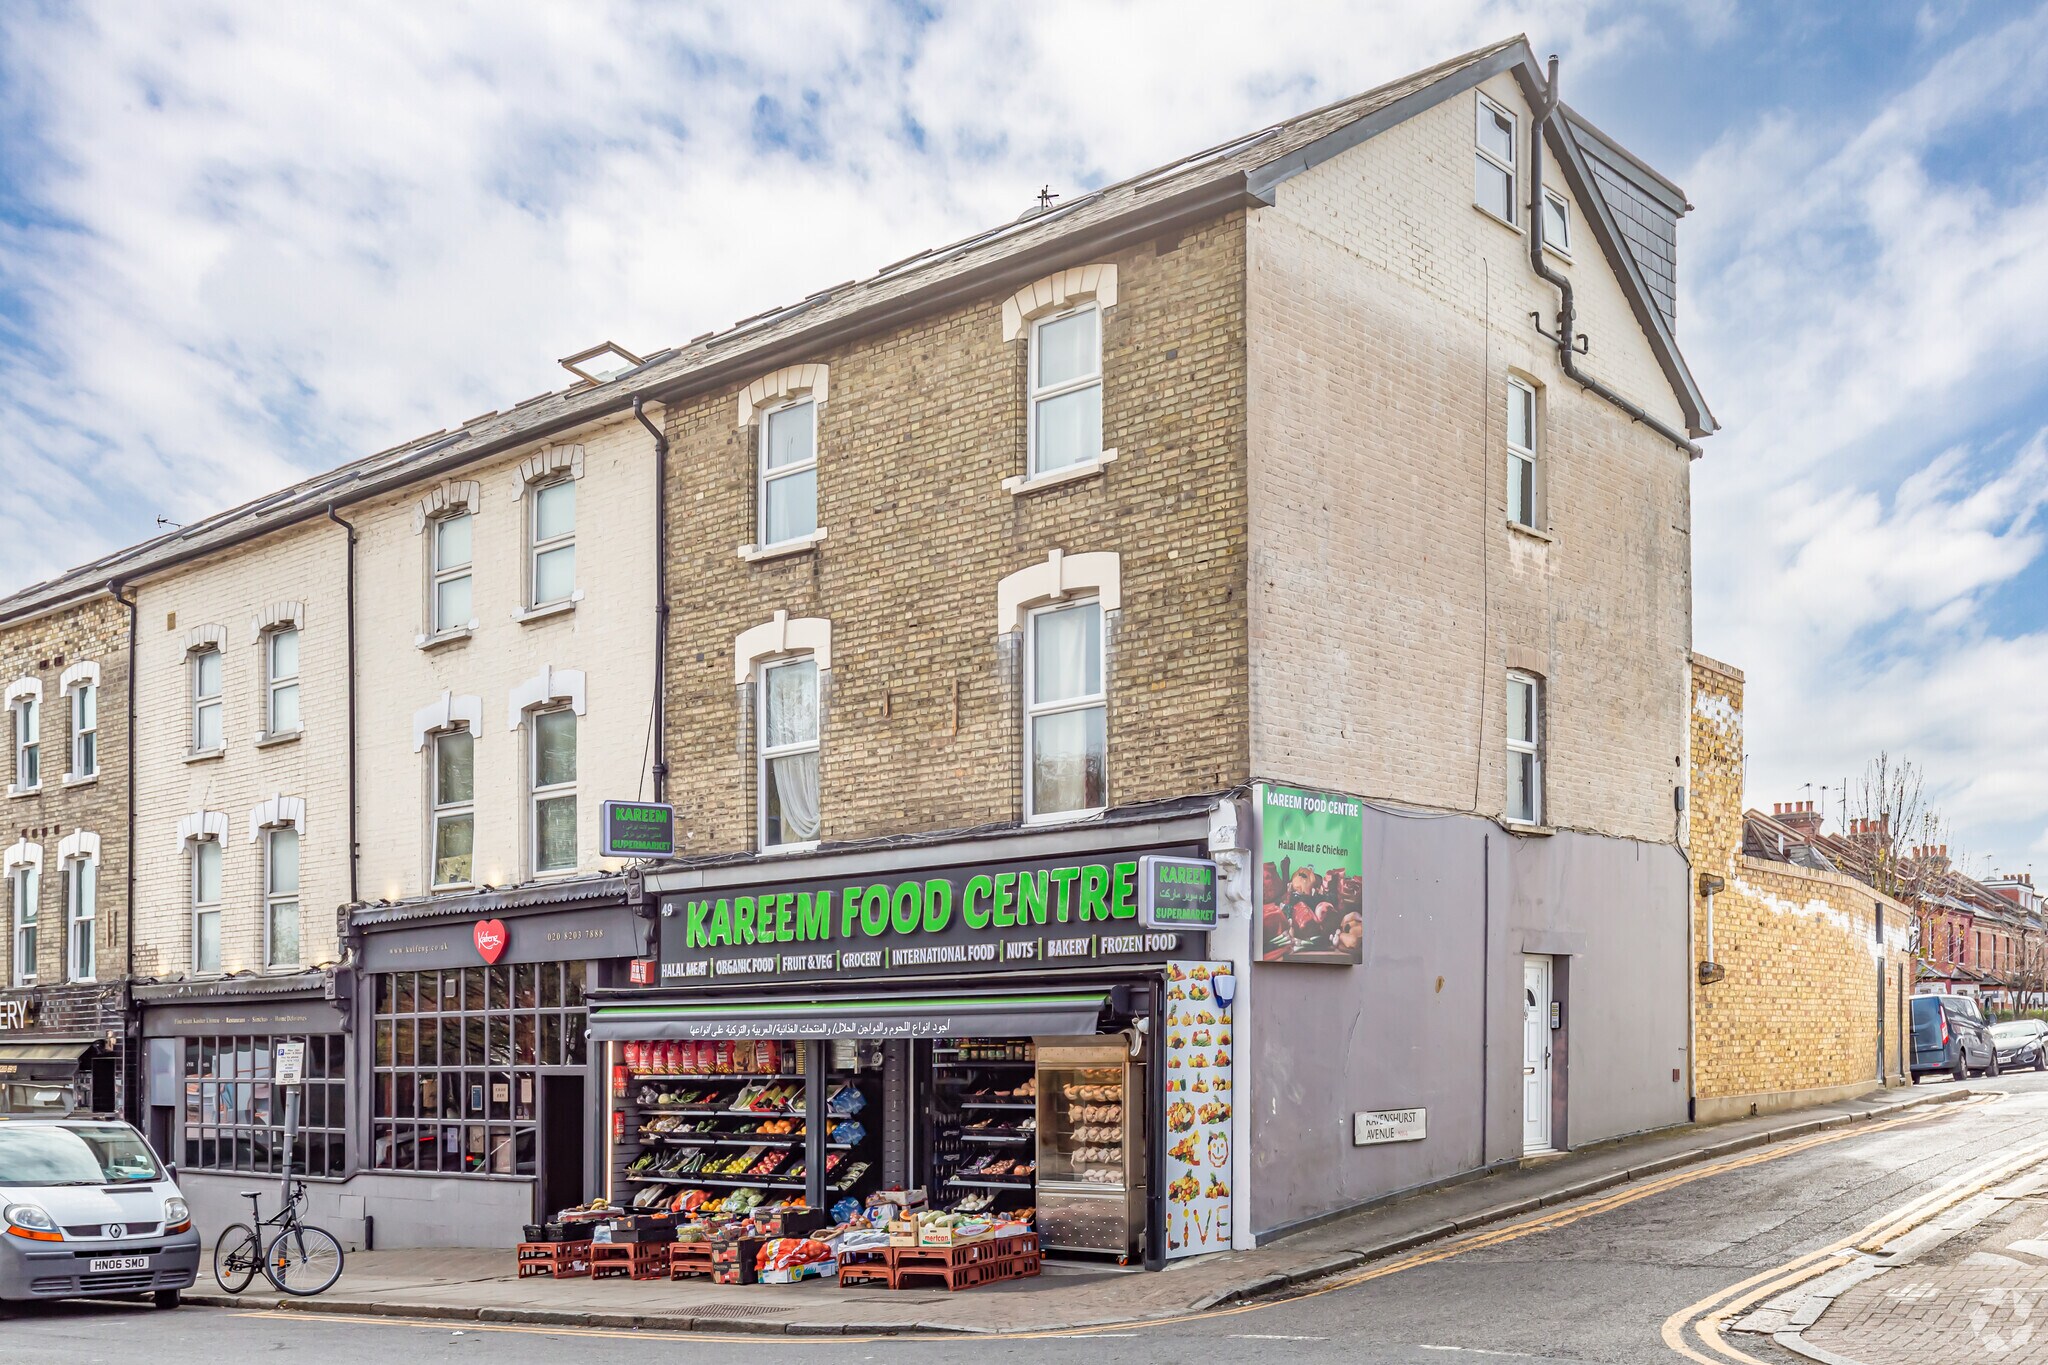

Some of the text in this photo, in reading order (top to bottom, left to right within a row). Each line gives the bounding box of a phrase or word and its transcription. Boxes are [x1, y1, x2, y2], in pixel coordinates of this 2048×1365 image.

[1267, 792, 1358, 817] KAREEM FOOD CENTRE
[616, 808, 668, 823] KAREEM
[612, 839, 671, 850] SUPERMARKET
[1278, 840, 1348, 856] Halal Meat & Chicken
[1160, 865, 1212, 886] KAREEM
[661, 903, 673, 918] 49
[686, 861, 1138, 949] KAREEM FOOD CENTRE
[1156, 907, 1215, 921] SUPERMARKET
[547, 932, 561, 941] 020
[1100, 933, 1177, 954] FROZEN FOOD
[892, 943, 995, 966] INTERNATIONAL FOOD
[1006, 940, 1034, 959] NUTS
[1047, 938, 1089, 958] BAKERY
[716, 956, 774, 976] ORGANIC FOOD
[782, 956, 807, 972] FRUIT
[842, 950, 882, 968] GROCERY
[661, 962, 686, 978] HALAL
[686, 960, 708, 977] MEAT
[0, 1000, 28, 1030] ERY
[1366, 1128, 1394, 1140] AVENUE
[94, 1258, 122, 1270] HN06
